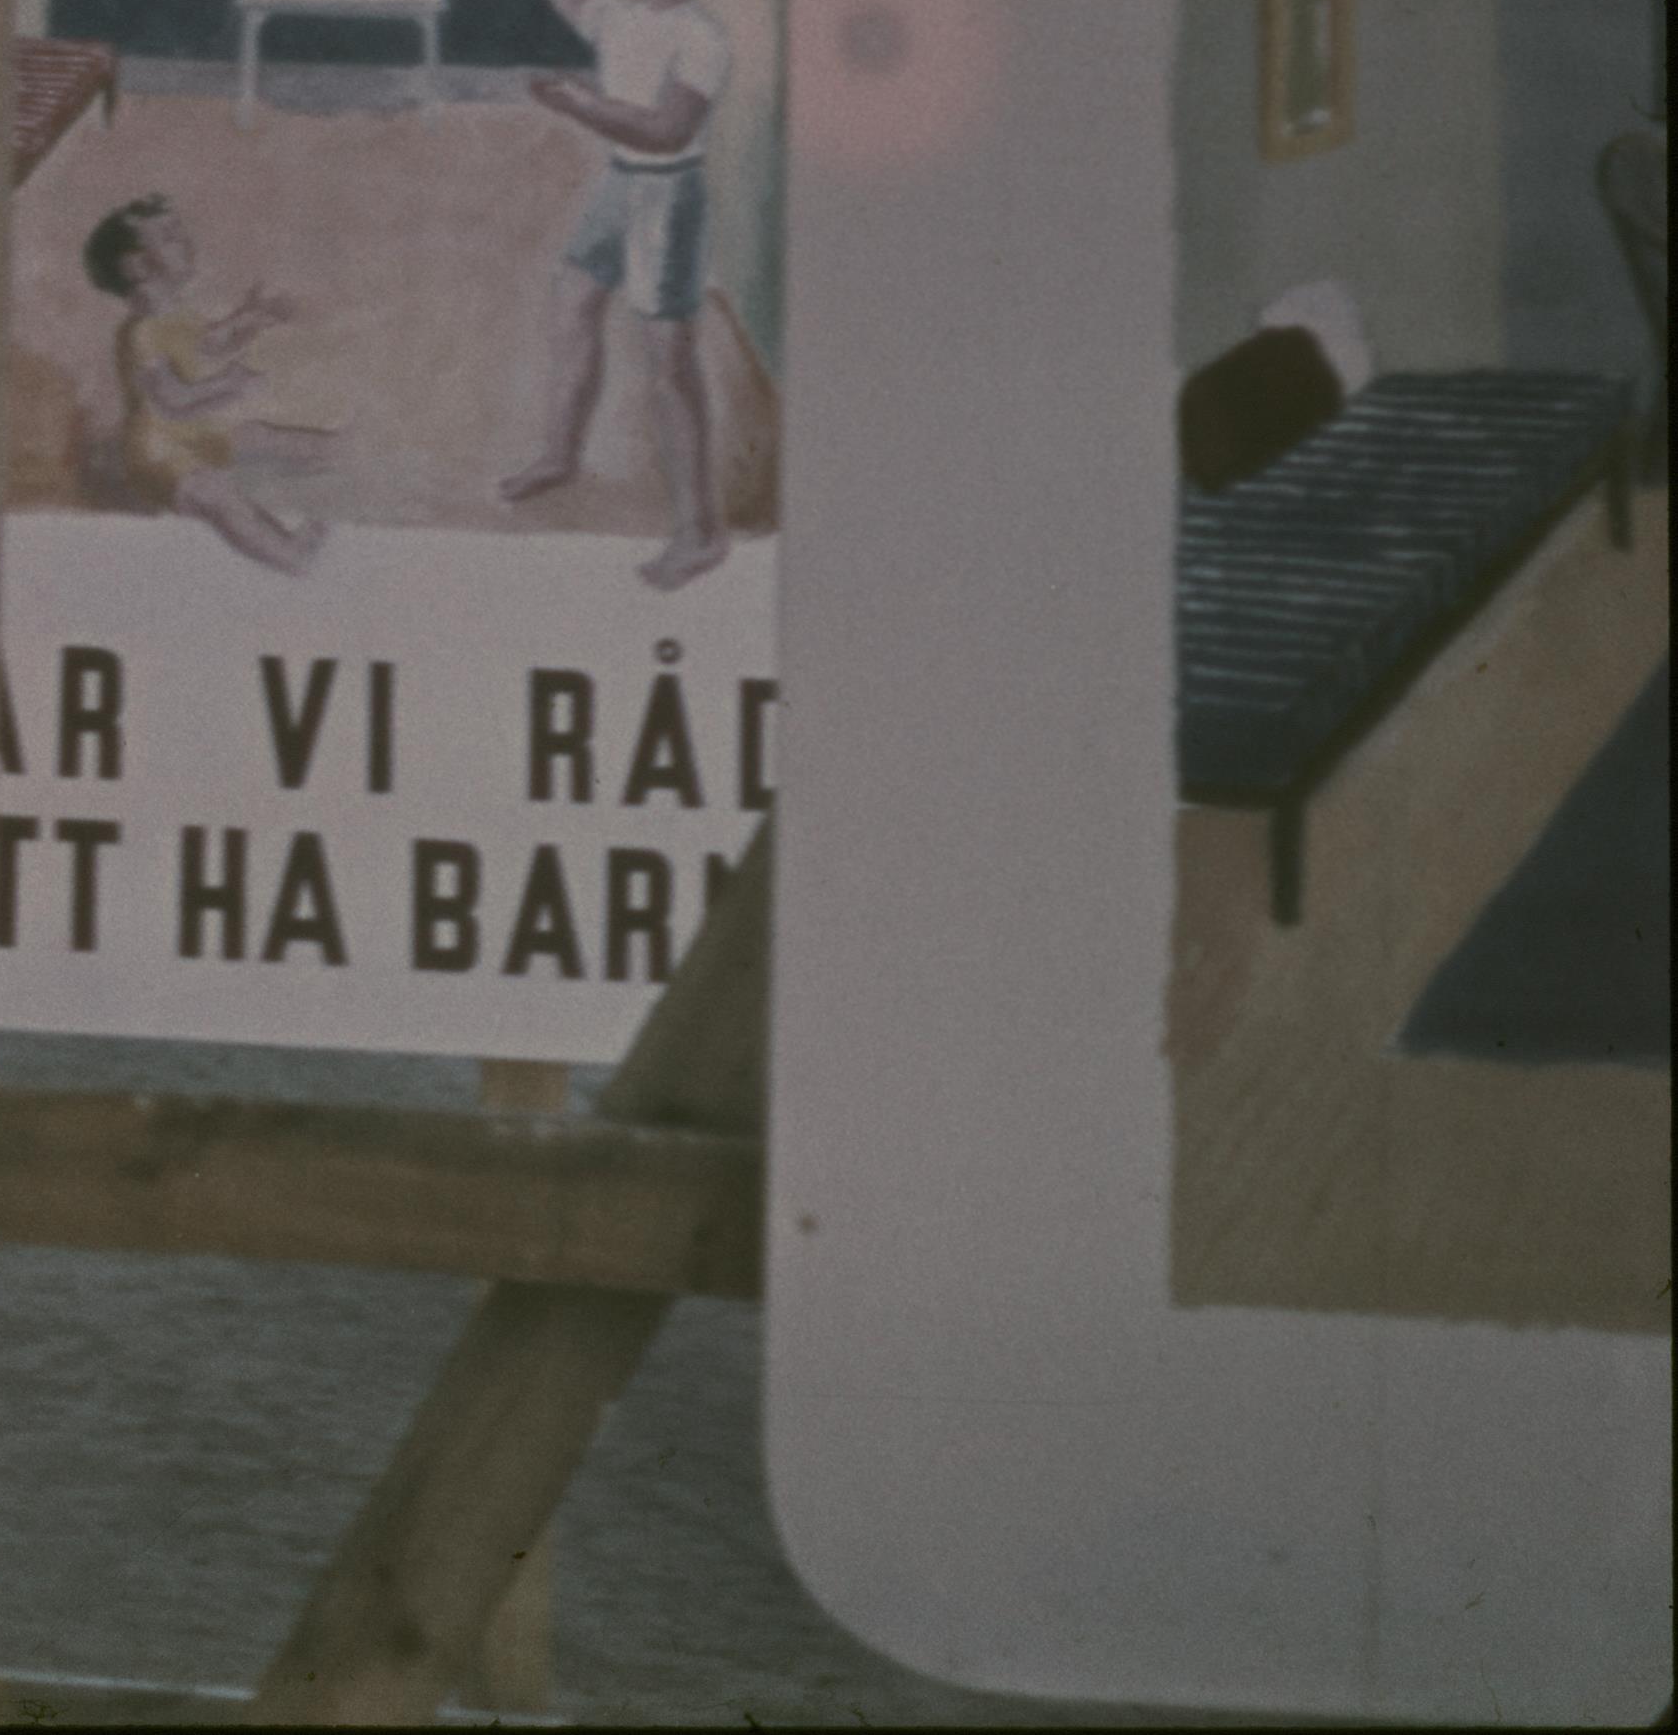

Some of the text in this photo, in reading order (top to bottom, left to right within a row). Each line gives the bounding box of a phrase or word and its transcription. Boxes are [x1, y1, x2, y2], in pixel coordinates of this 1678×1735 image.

[257, 654, 395, 795] VI
[176, 823, 350, 969] HA
[409, 836, 743, 984] BAR
